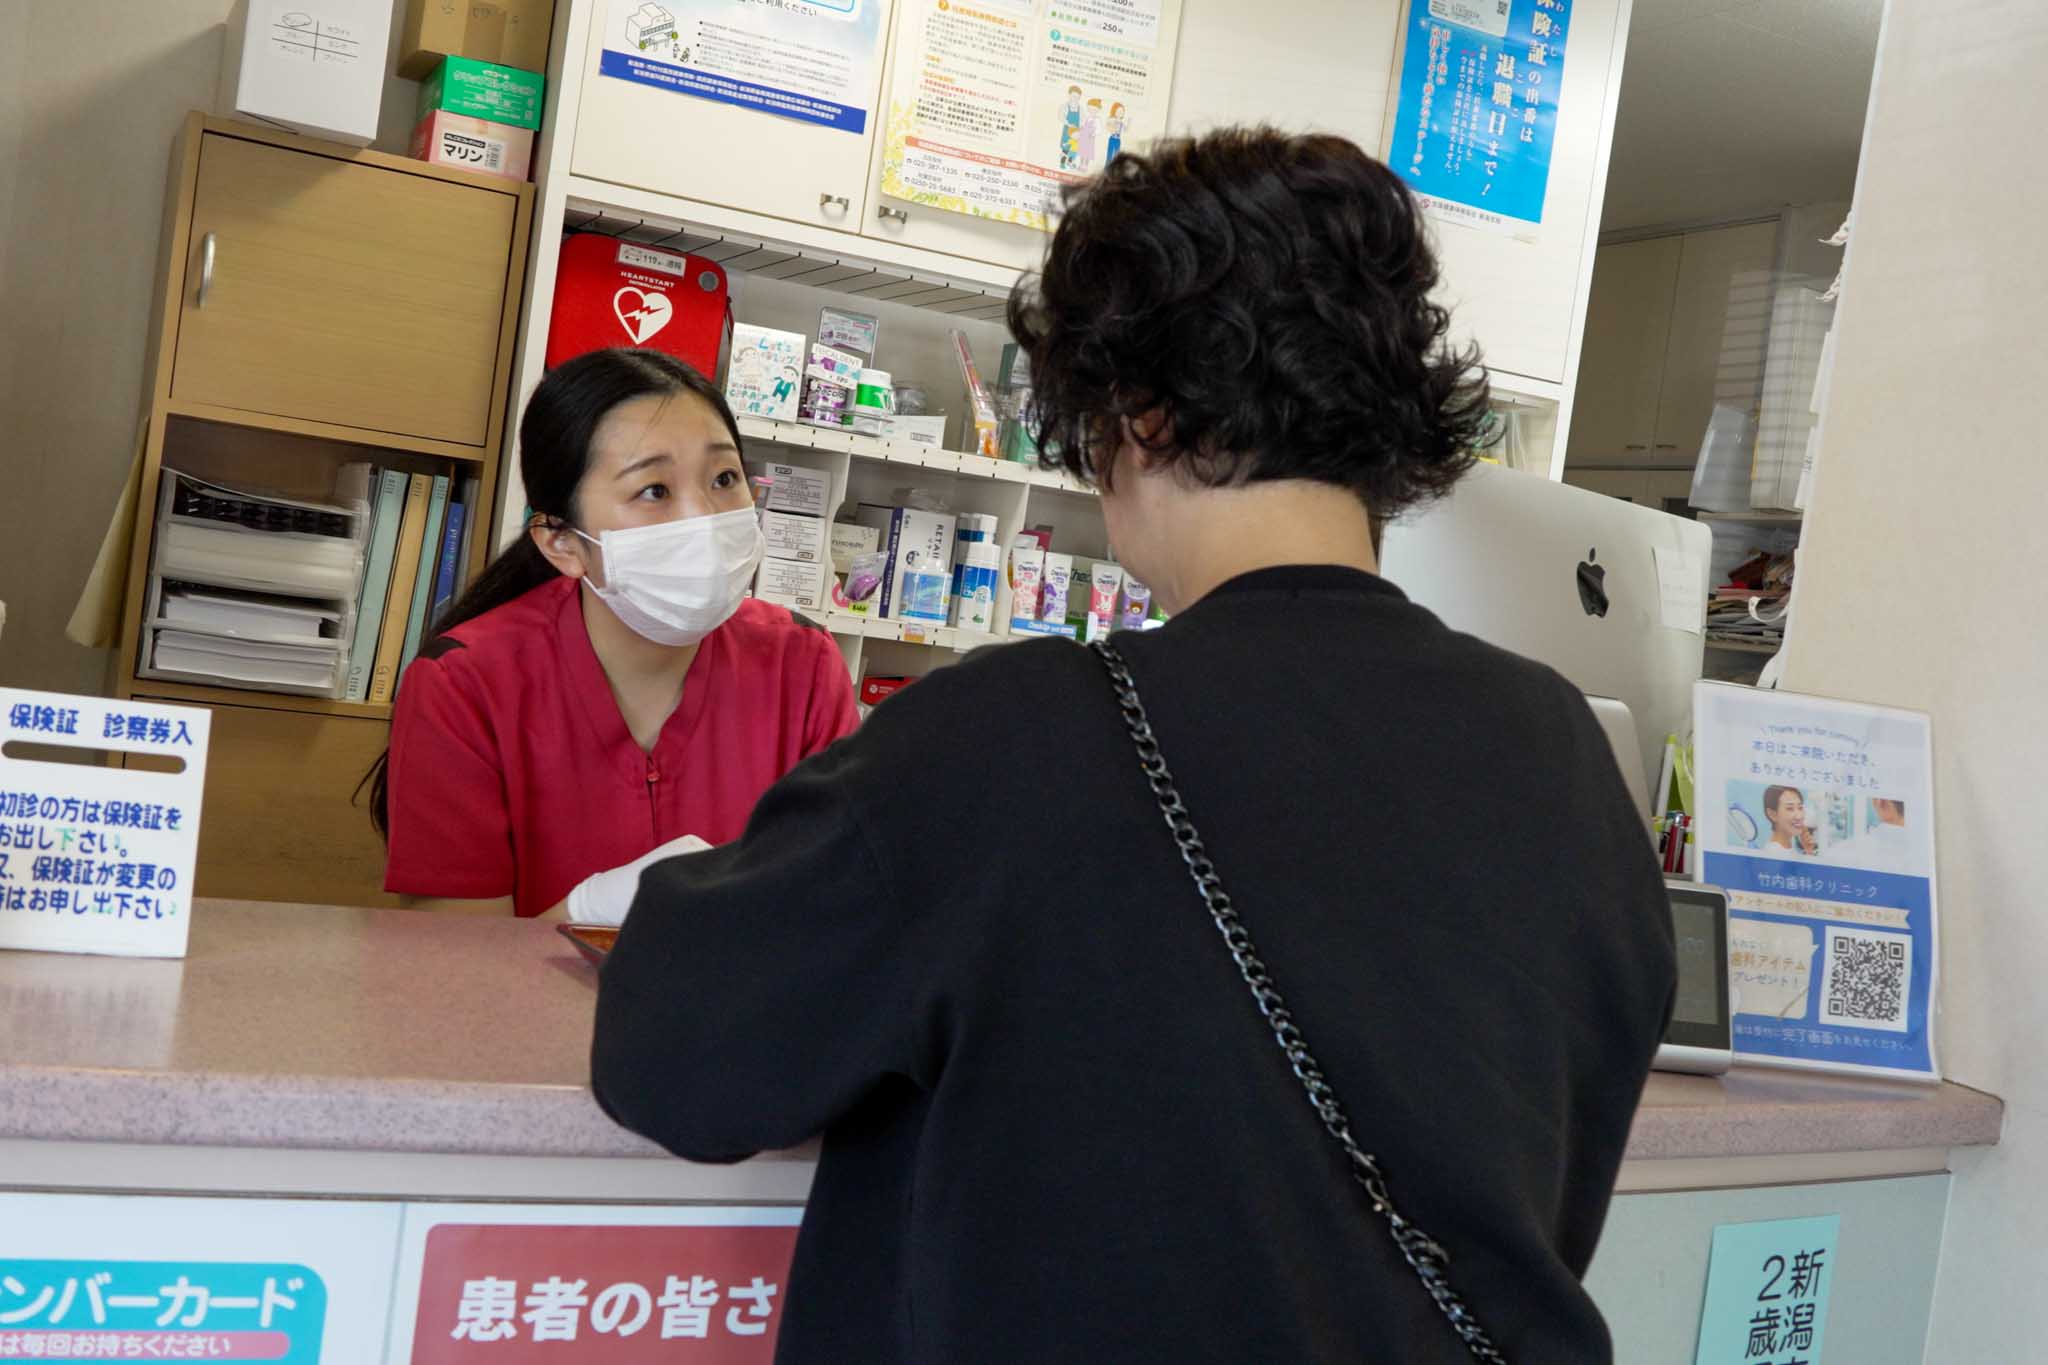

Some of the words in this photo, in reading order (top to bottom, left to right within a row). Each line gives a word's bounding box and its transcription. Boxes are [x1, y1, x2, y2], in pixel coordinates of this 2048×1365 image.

[444, 143, 483, 162] マリン
[620, 271, 675, 288] HEARTSTART
[9, 703, 80, 735] 保険証
[103, 713, 193, 746] 診察券入
[1750, 762, 1880, 789] ありがとうございました
[0, 791, 183, 831] 初診の方は保険証を
[0, 823, 129, 858] お出し下さい。
[1758, 872, 1879, 898] 竹内歯科クリニック
[0, 1272, 304, 1328] ンバーカード
[451, 1275, 778, 1342] 患者の皆さ
[1745, 1255, 1786, 1365] 2歳
[0, 1333, 231, 1358] は毎回お持ちください
